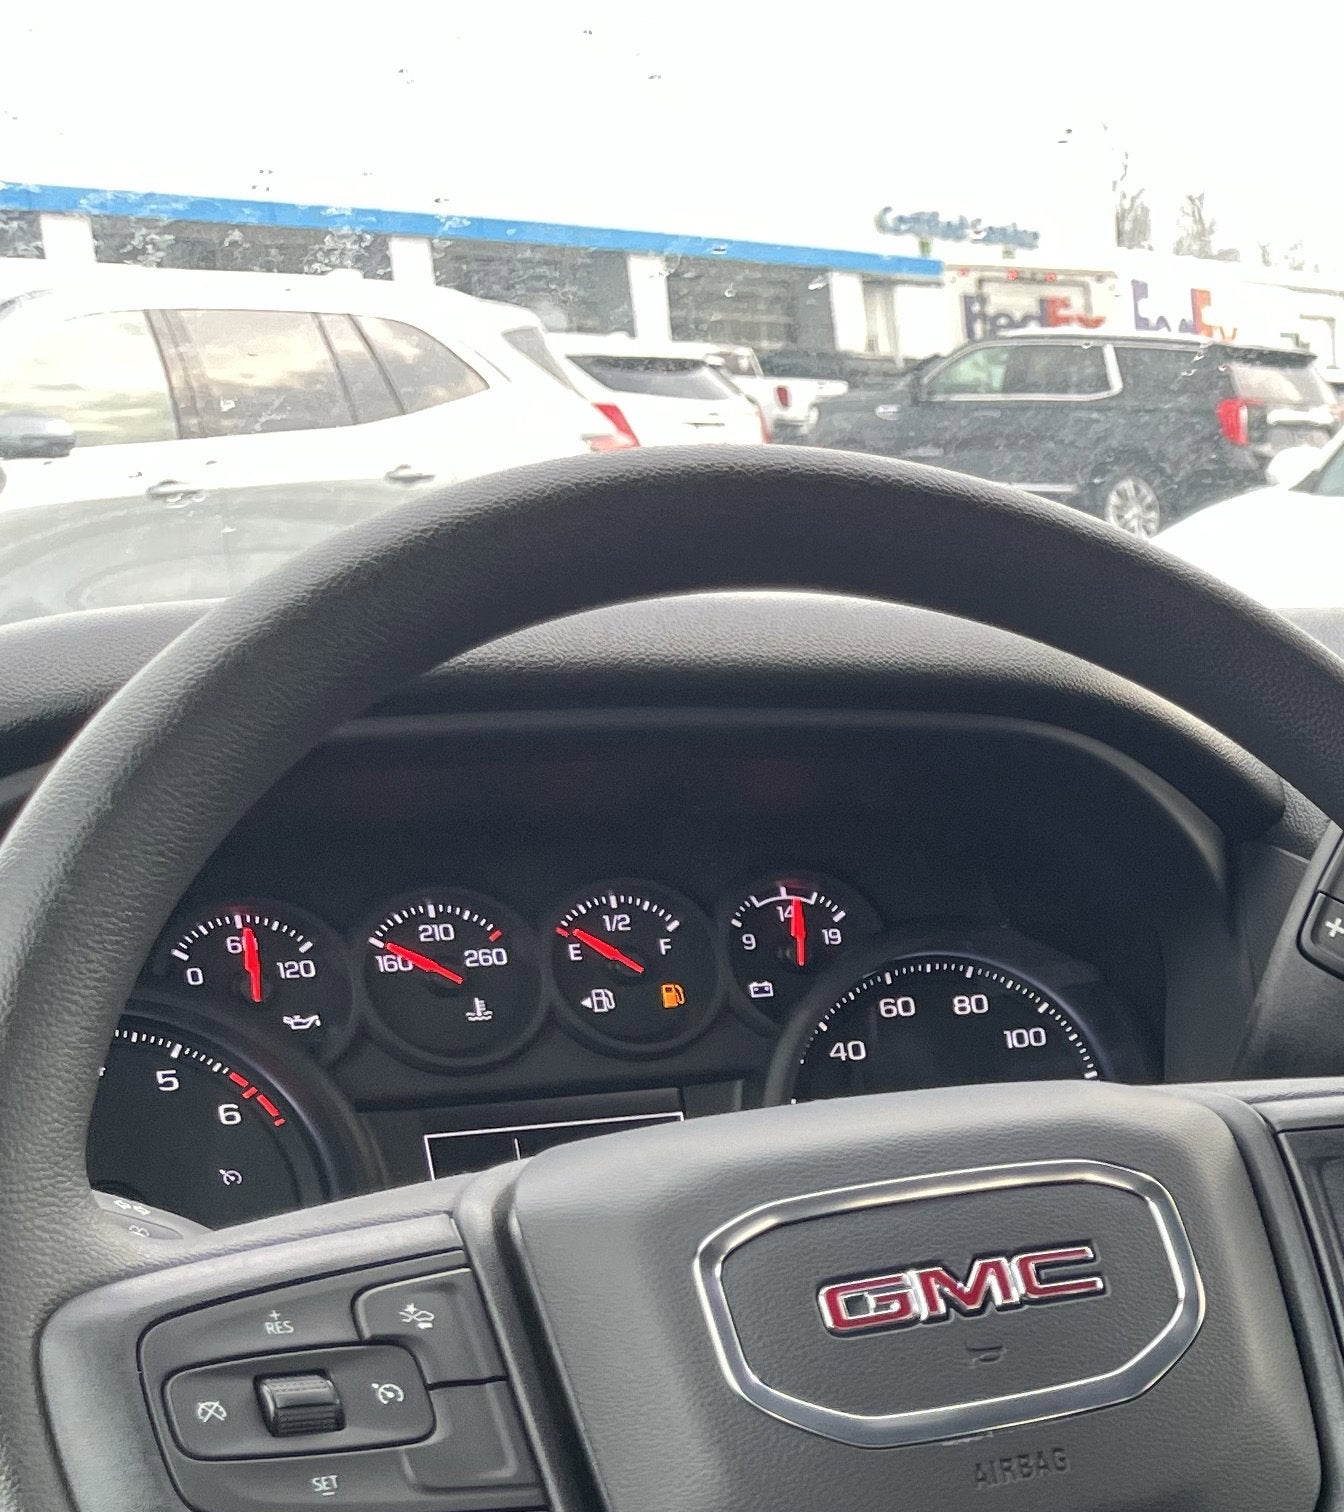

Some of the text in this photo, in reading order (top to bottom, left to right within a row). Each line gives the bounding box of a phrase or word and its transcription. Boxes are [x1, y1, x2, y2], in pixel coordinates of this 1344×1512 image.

[418, 923, 455, 942] 210
[602, 914, 632, 932] 1/2
[742, 933, 757, 950] 9
[821, 928, 842, 945] 19
[568, 943, 582, 961] E
[659, 938, 672, 955] F
[375, 955, 415, 973] 160
[464, 948, 508, 967] 260
[186, 967, 205, 987] 0
[276, 960, 316, 979] 120
[879, 996, 916, 1019] 60
[952, 993, 989, 1015] 80
[1003, 1027, 1047, 1049] 100
[829, 1040, 867, 1062] 40
[155, 1069, 180, 1092] 5
[218, 1102, 243, 1126] 6
[819, 1246, 1104, 1333] GMC
[264, 1320, 295, 1335] RES
[973, 1447, 1069, 1489] AIRBAG
[312, 1474, 339, 1492] SET
